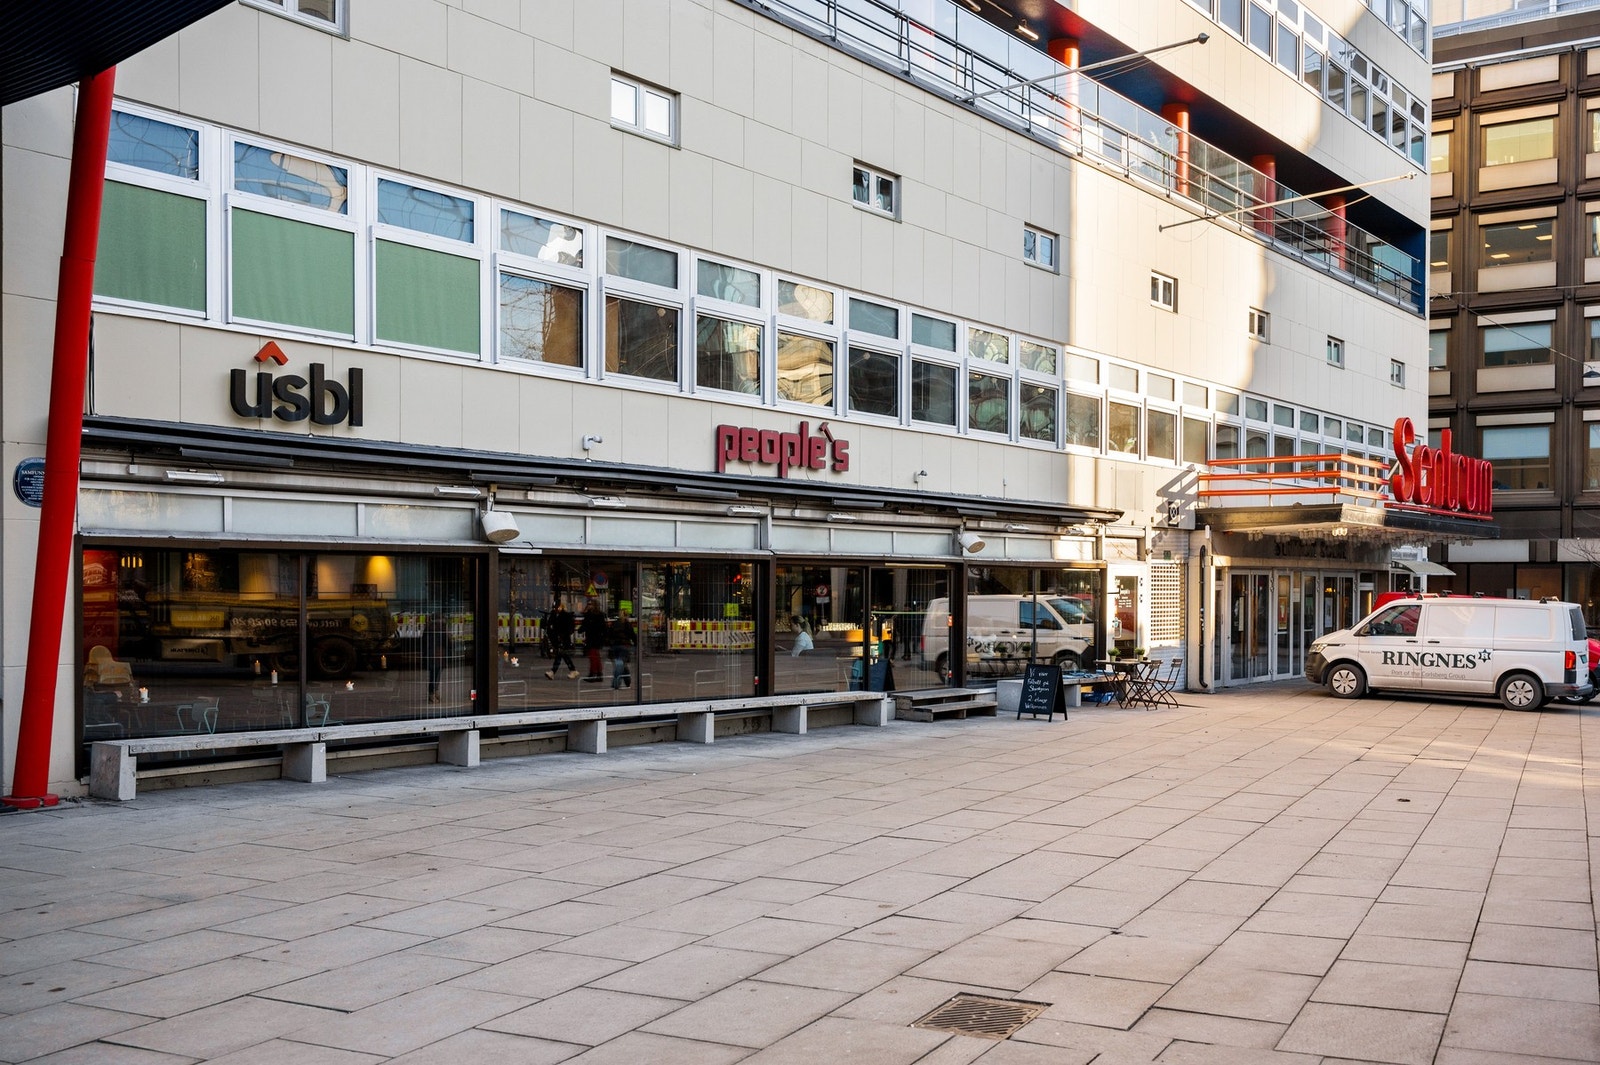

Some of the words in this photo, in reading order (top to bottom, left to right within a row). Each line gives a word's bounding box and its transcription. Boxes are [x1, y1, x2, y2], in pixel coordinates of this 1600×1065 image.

[715, 420, 850, 479] people's
[1382, 650, 1477, 669] RINGNES
[1421, 671, 1447, 679] Carlsberg
[1448, 672, 1466, 680] Group
